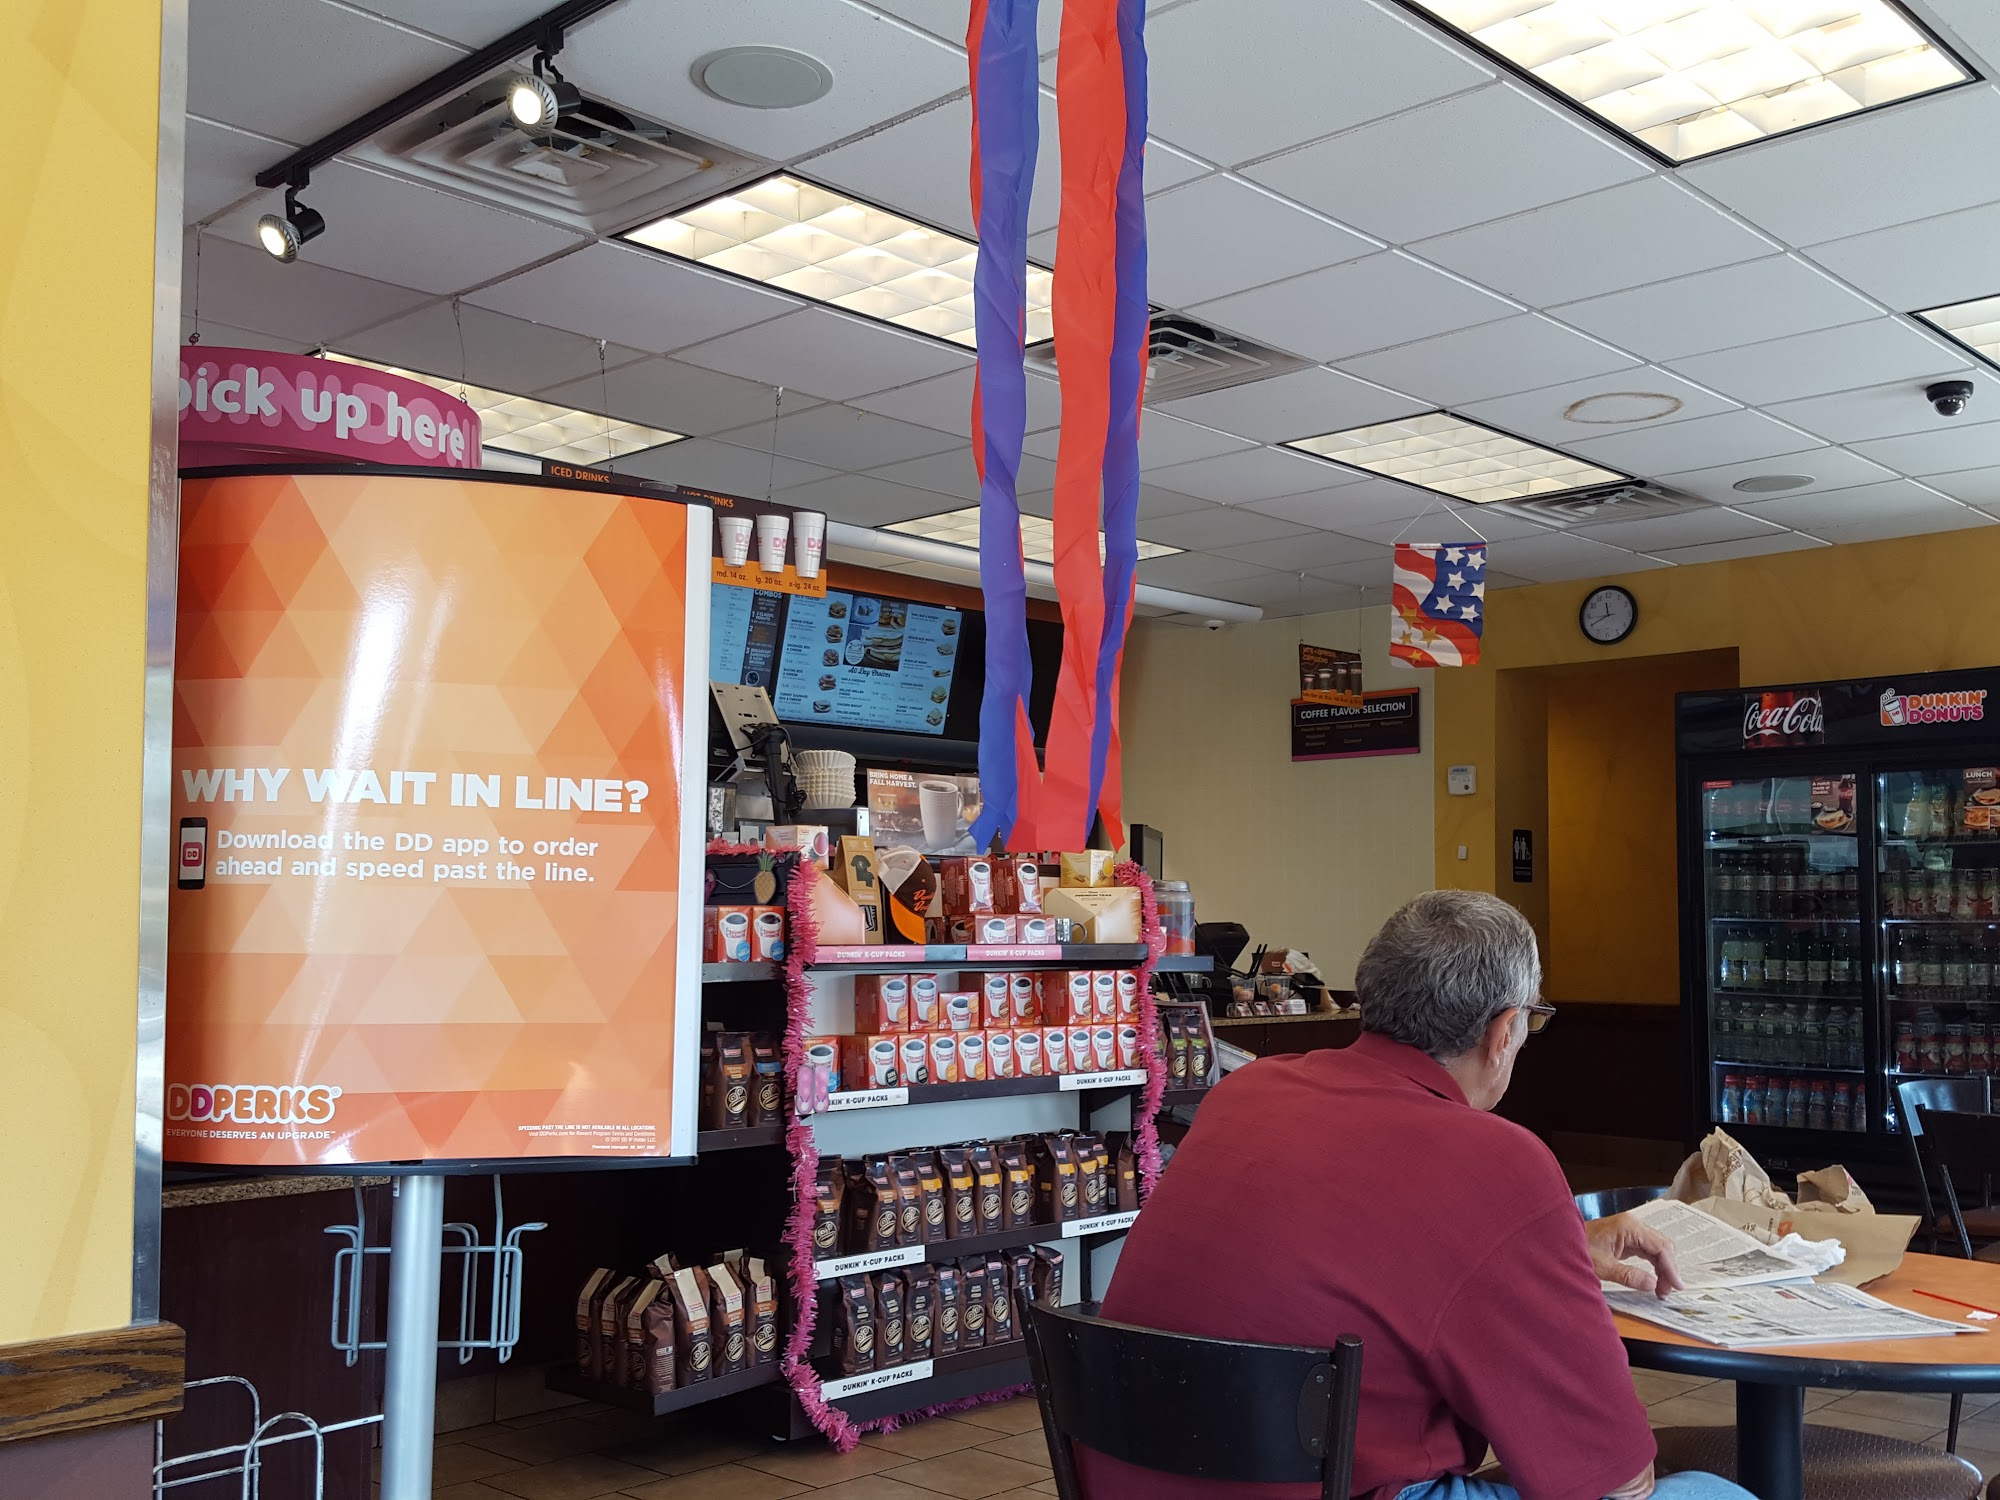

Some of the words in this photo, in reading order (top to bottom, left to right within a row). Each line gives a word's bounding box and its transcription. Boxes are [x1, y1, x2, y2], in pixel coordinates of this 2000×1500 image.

[301, 388, 368, 440] up
[387, 390, 465, 461] here
[551, 465, 573, 478] ICED
[576, 470, 610, 483] DRINKS
[716, 570, 729, 578] md.
[730, 571, 737, 579] 14
[789, 581, 801, 590] x-lg.
[754, 589, 783, 599] COMBOS
[1908, 690, 1987, 709] DUNKIN'
[1300, 709, 1329, 720] COFFEE
[1331, 708, 1360, 717] FLAVOR
[1362, 702, 1406, 714] SELECTION
[1743, 697, 1824, 739] Coca-Cola
[1908, 706, 1984, 724] DONUTS
[869, 771, 888, 779] BRING
[886, 780, 917, 788] HARVEST.
[182, 768, 290, 802] WHY
[302, 768, 437, 805] WAIT
[450, 773, 501, 808] IN
[516, 775, 650, 814] LINE?
[218, 830, 334, 850] Download
[342, 831, 385, 852] the
[395, 832, 433, 852] DD
[442, 837, 490, 857] app
[498, 836, 525, 855] to
[533, 837, 599, 857] order
[215, 856, 283, 876] ahead
[291, 857, 337, 876] and
[346, 859, 424, 880] speed
[433, 862, 488, 882] past
[496, 861, 536, 881] the
[545, 862, 595, 882] line.
[837, 950, 863, 959] DUNKIN'
[864, 950, 883, 958] K-CUP
[885, 950, 906, 958] PACKS
[846, 1095, 866, 1104] K-CUP
[868, 1094, 888, 1103] PACKS
[166, 1128, 208, 1138] EVERYONE
[209, 1130, 257, 1139] DESERVES
[259, 1131, 275, 1140] AN
[1079, 1221, 1100, 1231] DUNKIN'
[1101, 1219, 1116, 1228] K-CUP
[1117, 1216, 1134, 1226] PACKS
[835, 1261, 862, 1272] DUNKIN'
[862, 1257, 883, 1267] K-CUP
[884, 1253, 905, 1263] PACKS
[842, 1379, 869, 1392] DUNKIN'
[871, 1374, 892, 1386] K-CUP
[893, 1370, 913, 1381] PACKS
